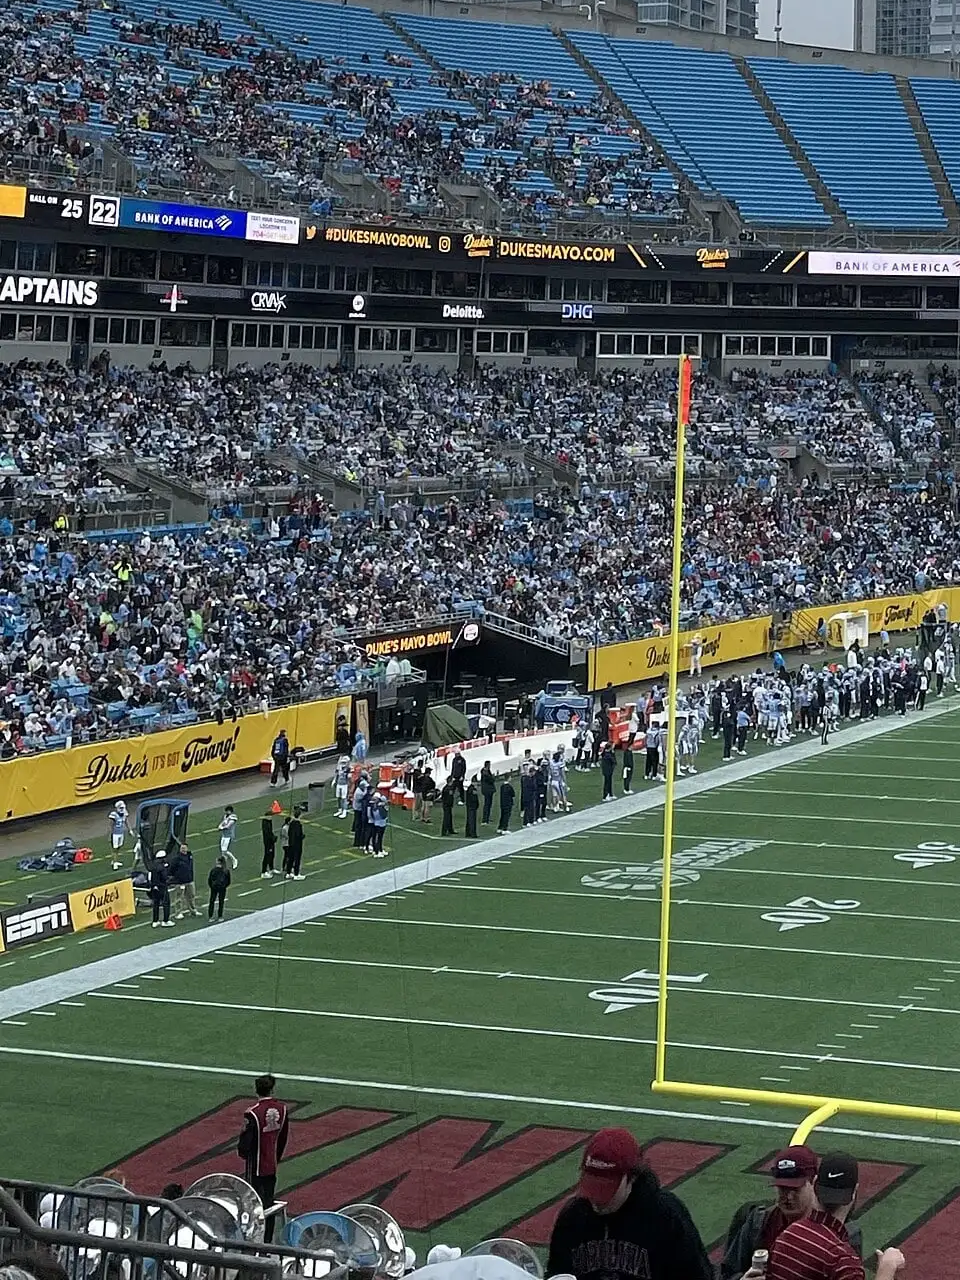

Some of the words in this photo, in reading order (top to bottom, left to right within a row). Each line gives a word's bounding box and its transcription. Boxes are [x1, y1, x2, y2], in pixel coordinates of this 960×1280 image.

[29, 194, 46, 203] BALL
[61, 199, 83, 218] 25
[92, 201, 116, 223] 22
[135, 212, 159, 225] BANK
[162, 215, 174, 225] OF
[174, 216, 214, 230] AMERICA
[326, 227, 432, 249] #DUKESMAYOBOWL
[463, 233, 494, 250] Duke's
[500, 241, 615, 262] DUKESMAYO.COM
[835, 261, 869, 271] BANK
[872, 262, 889, 271] OF
[892, 262, 950, 273] AMERICA
[0, 275, 98, 306] APTAINS
[562, 304, 593, 319] DHG
[366, 639, 399, 657] DUKE'S
[400, 634, 426, 651] MAYO
[427, 630, 454, 647] BOWL
[88, 753, 149, 788] Duke's
[152, 756, 165, 771] IT'S
[181, 726, 241, 773] Twang!
[84, 886, 119, 913] Duke's
[760, 896, 861, 924] 20
[6, 901, 69, 943] ESPN
[588, 969, 709, 1004] 10
